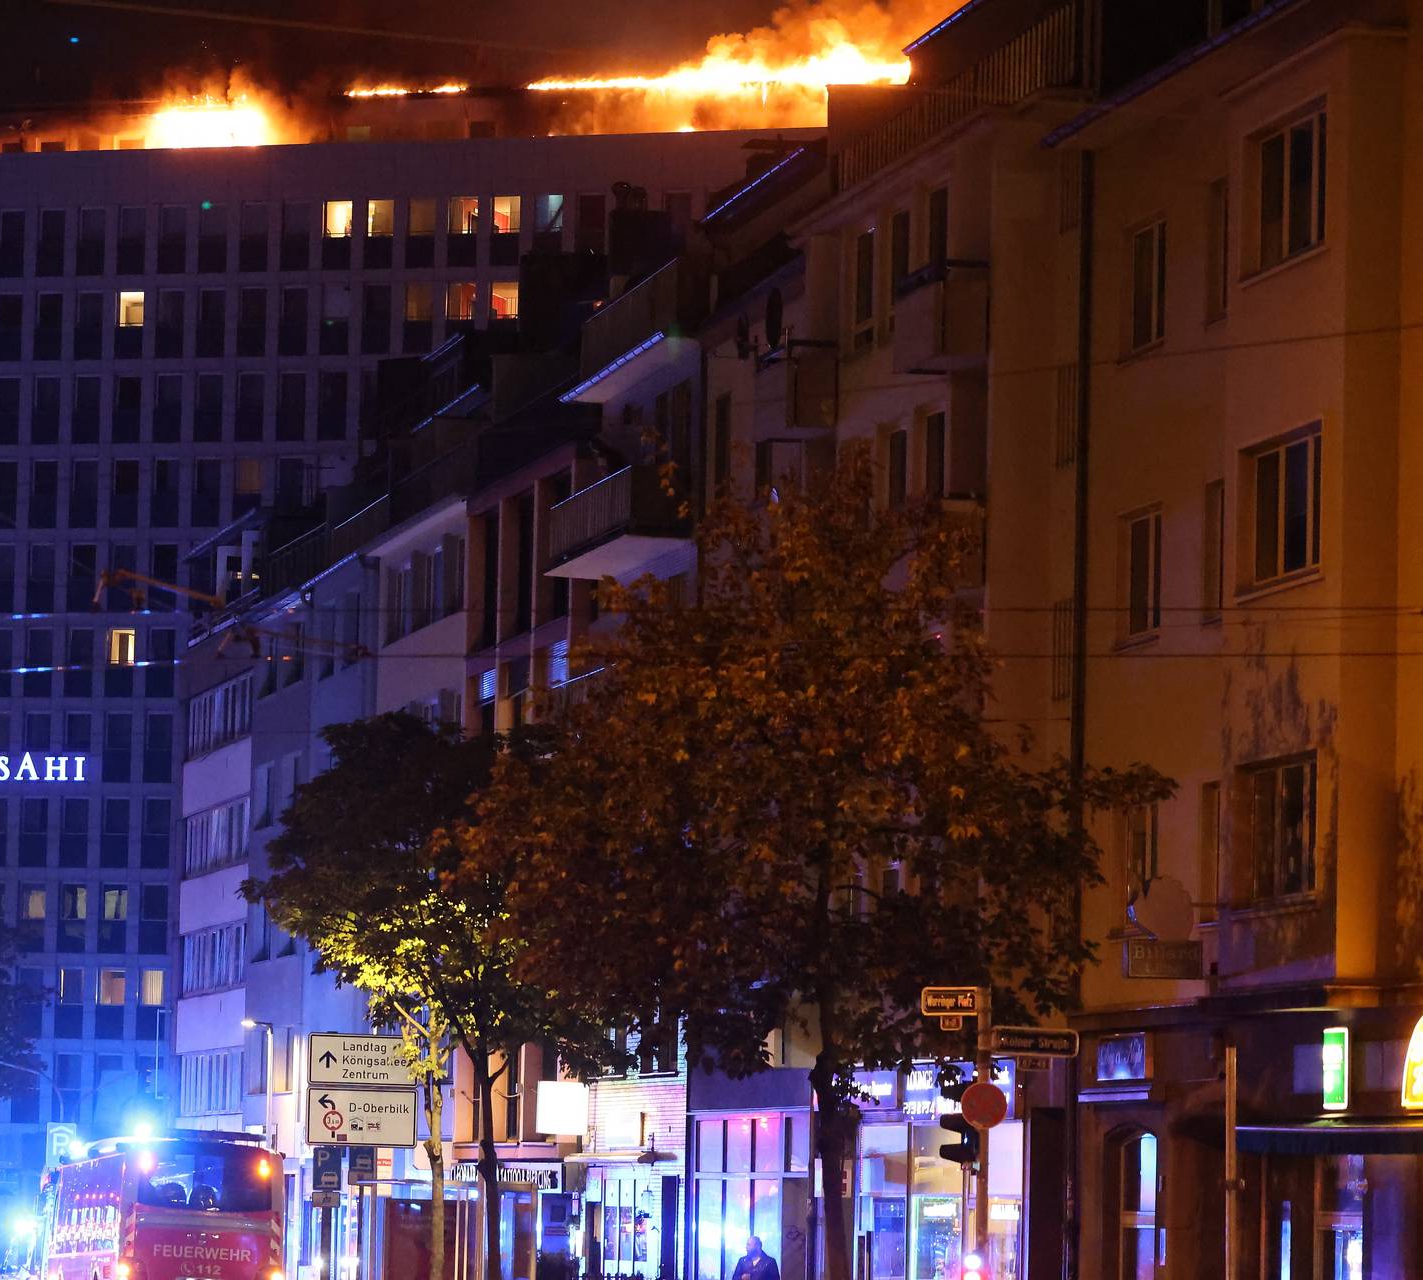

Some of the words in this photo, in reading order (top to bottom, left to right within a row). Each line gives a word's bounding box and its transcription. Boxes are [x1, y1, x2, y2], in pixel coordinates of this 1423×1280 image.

[343, 1041, 387, 1054] Landtag
[342, 1069, 389, 1080] Zentrum
[906, 1070, 934, 1091] LOUNGE
[349, 1102, 409, 1114] D-Oberbilk
[153, 1243, 252, 1262] FEUERWEHR
[197, 1264, 222, 1276] 112
